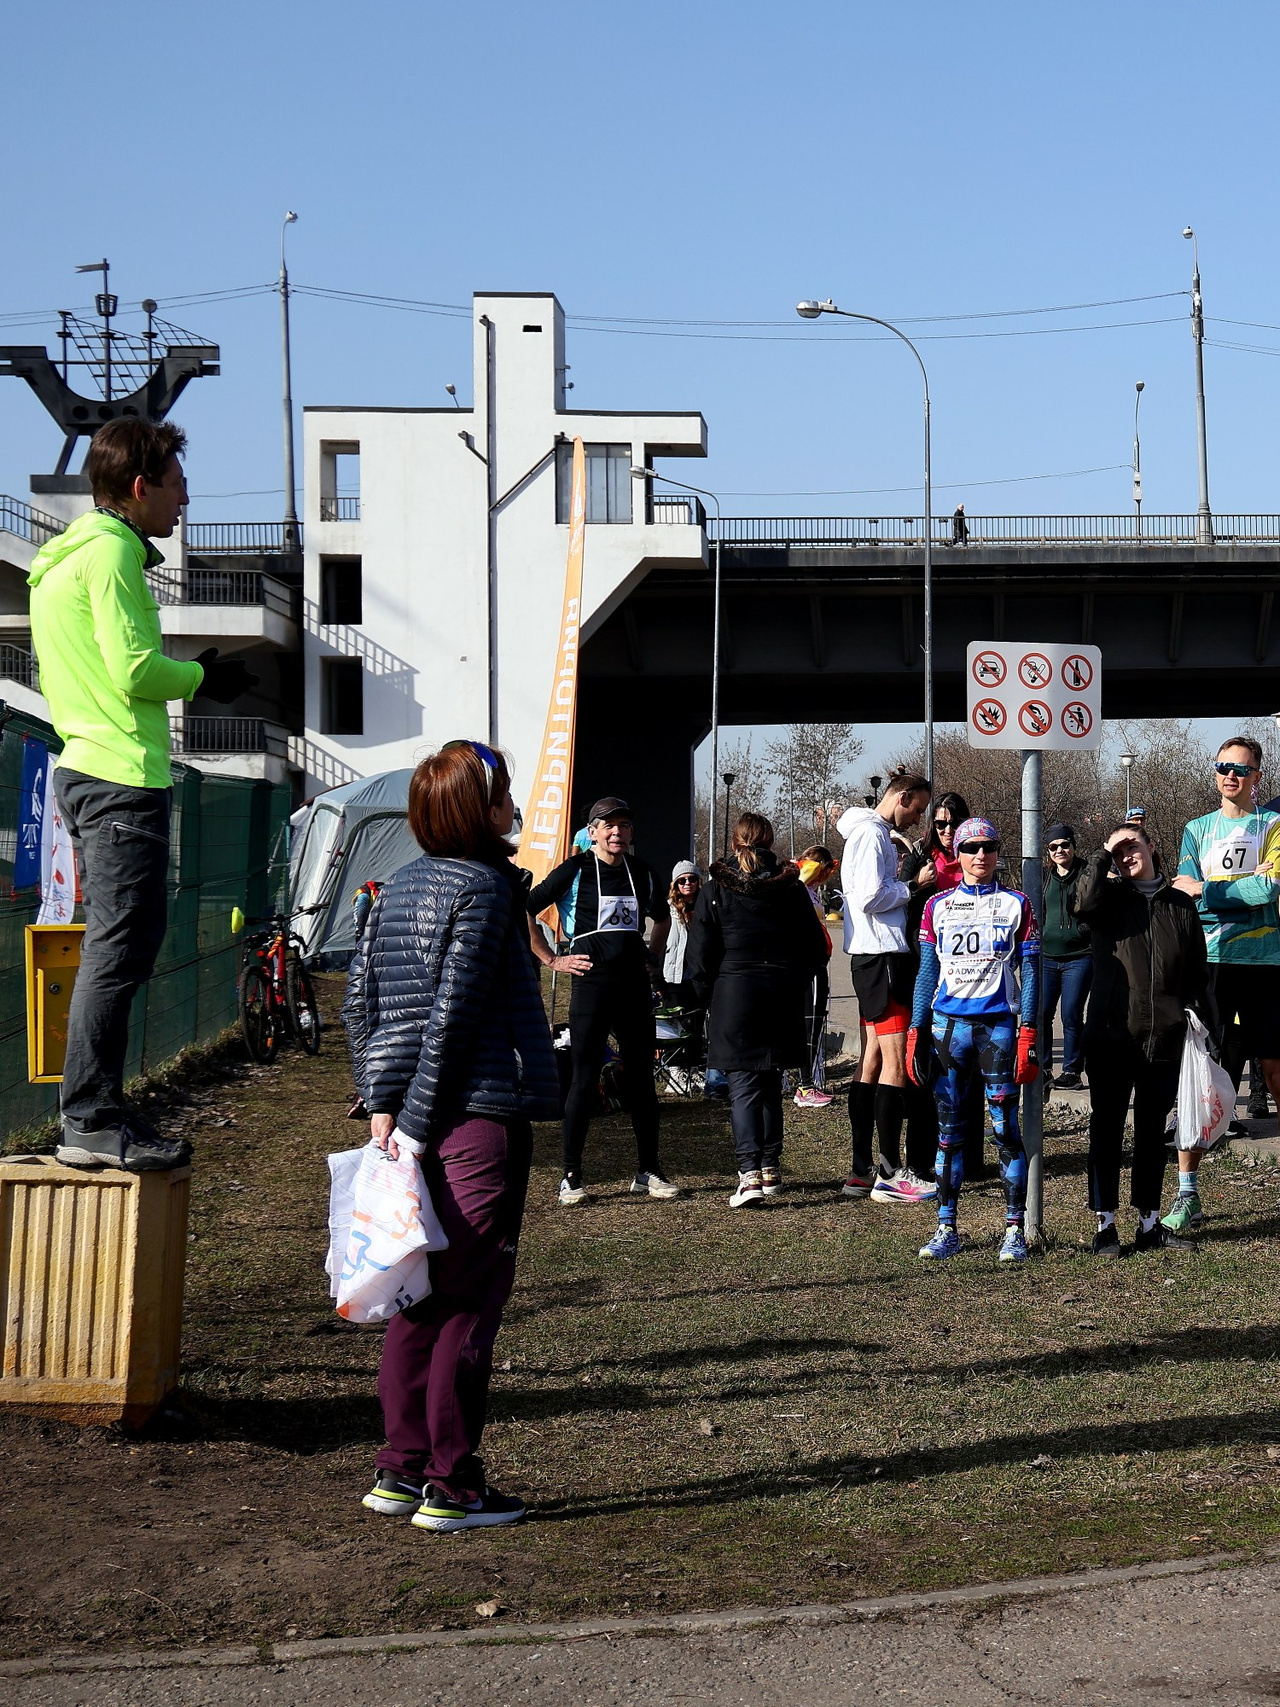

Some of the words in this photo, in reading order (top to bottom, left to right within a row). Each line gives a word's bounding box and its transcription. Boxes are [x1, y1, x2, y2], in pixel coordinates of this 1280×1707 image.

[1222, 848, 1247, 870] 67
[609, 907, 633, 925] 68
[951, 931, 980, 956] 20
